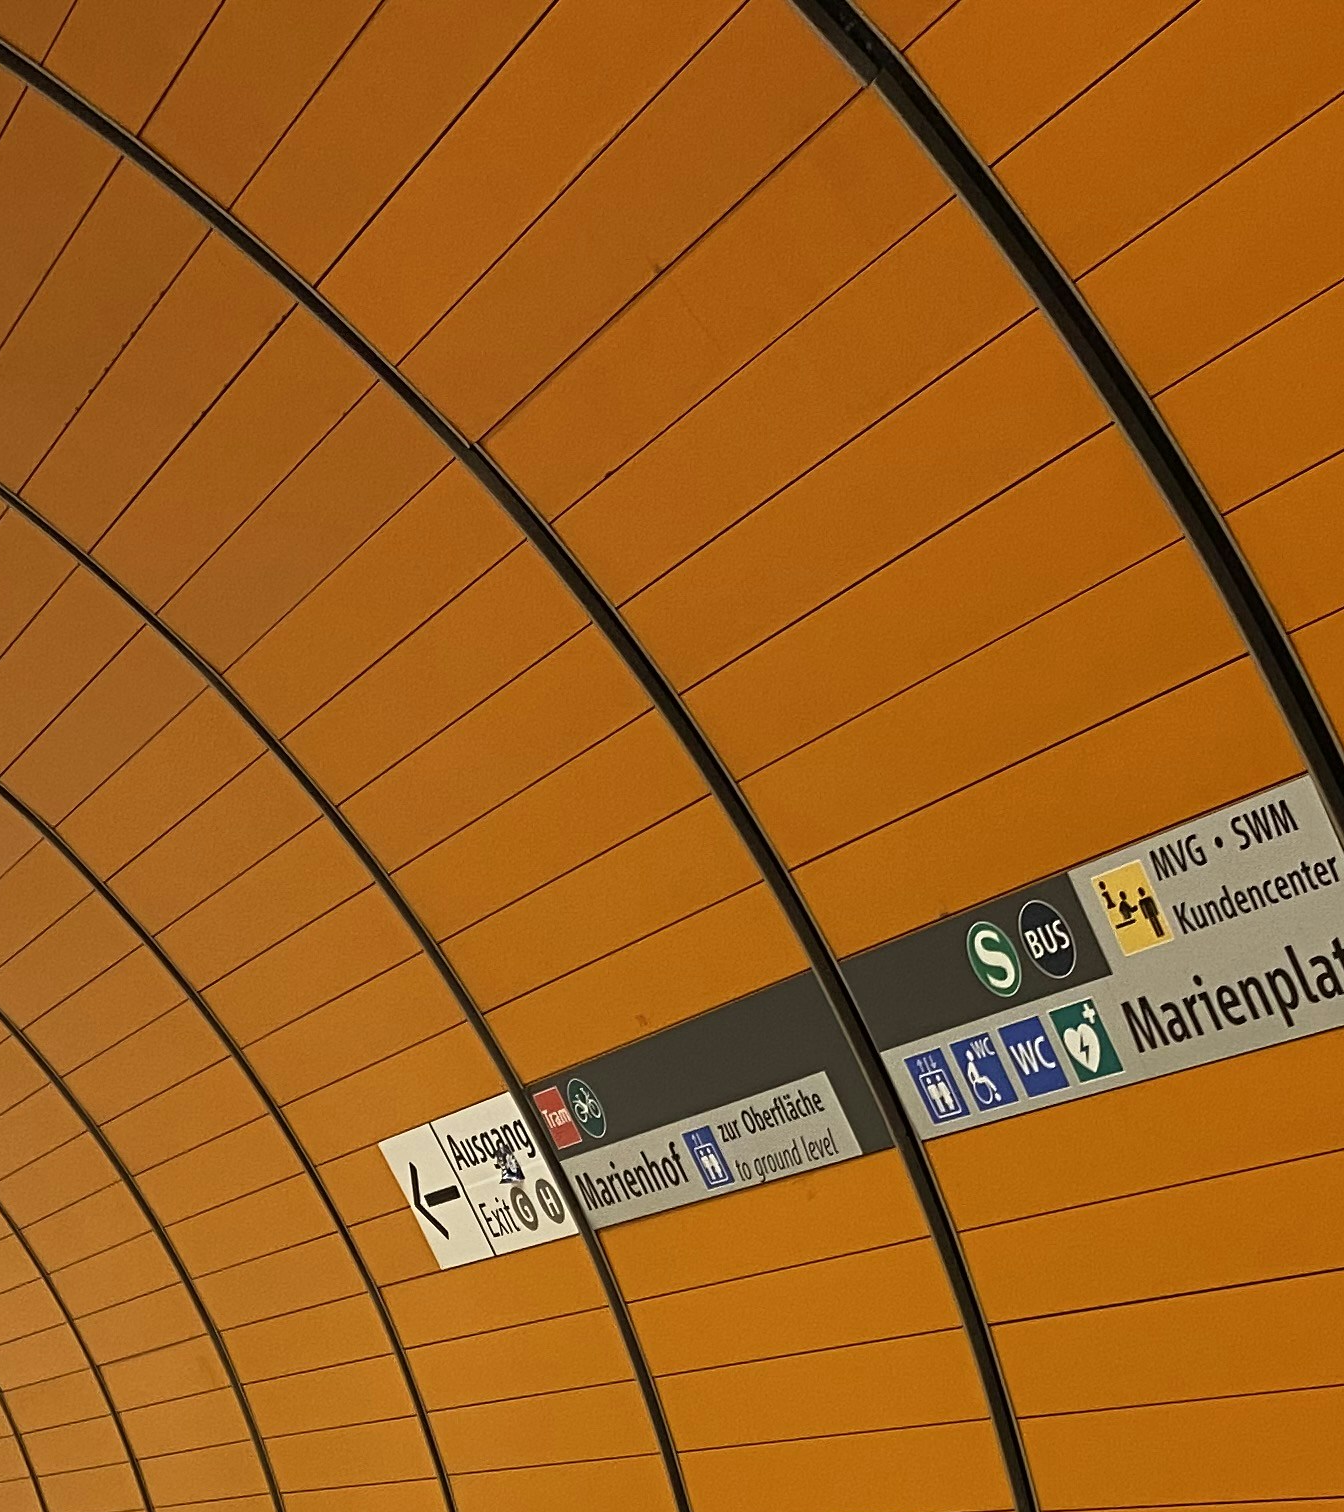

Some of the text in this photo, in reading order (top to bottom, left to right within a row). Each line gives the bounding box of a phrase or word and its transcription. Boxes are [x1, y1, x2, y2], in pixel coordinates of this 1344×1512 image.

[1149, 834, 1208, 881] MVG
[1231, 800, 1299, 851] SWM
[1172, 855, 1340, 935] Kundencenter
[974, 929, 1016, 989] S
[1024, 919, 1071, 959] BUS
[971, 1036, 996, 1059] WC
[1010, 1034, 1057, 1077] WC
[542, 1107, 573, 1129] Tram
[717, 1089, 825, 1142] zur Oberfläche
[574, 1141, 689, 1211] Marienhof
[735, 1127, 839, 1182] to ground level
[478, 1186, 561, 1238] Exit G H
